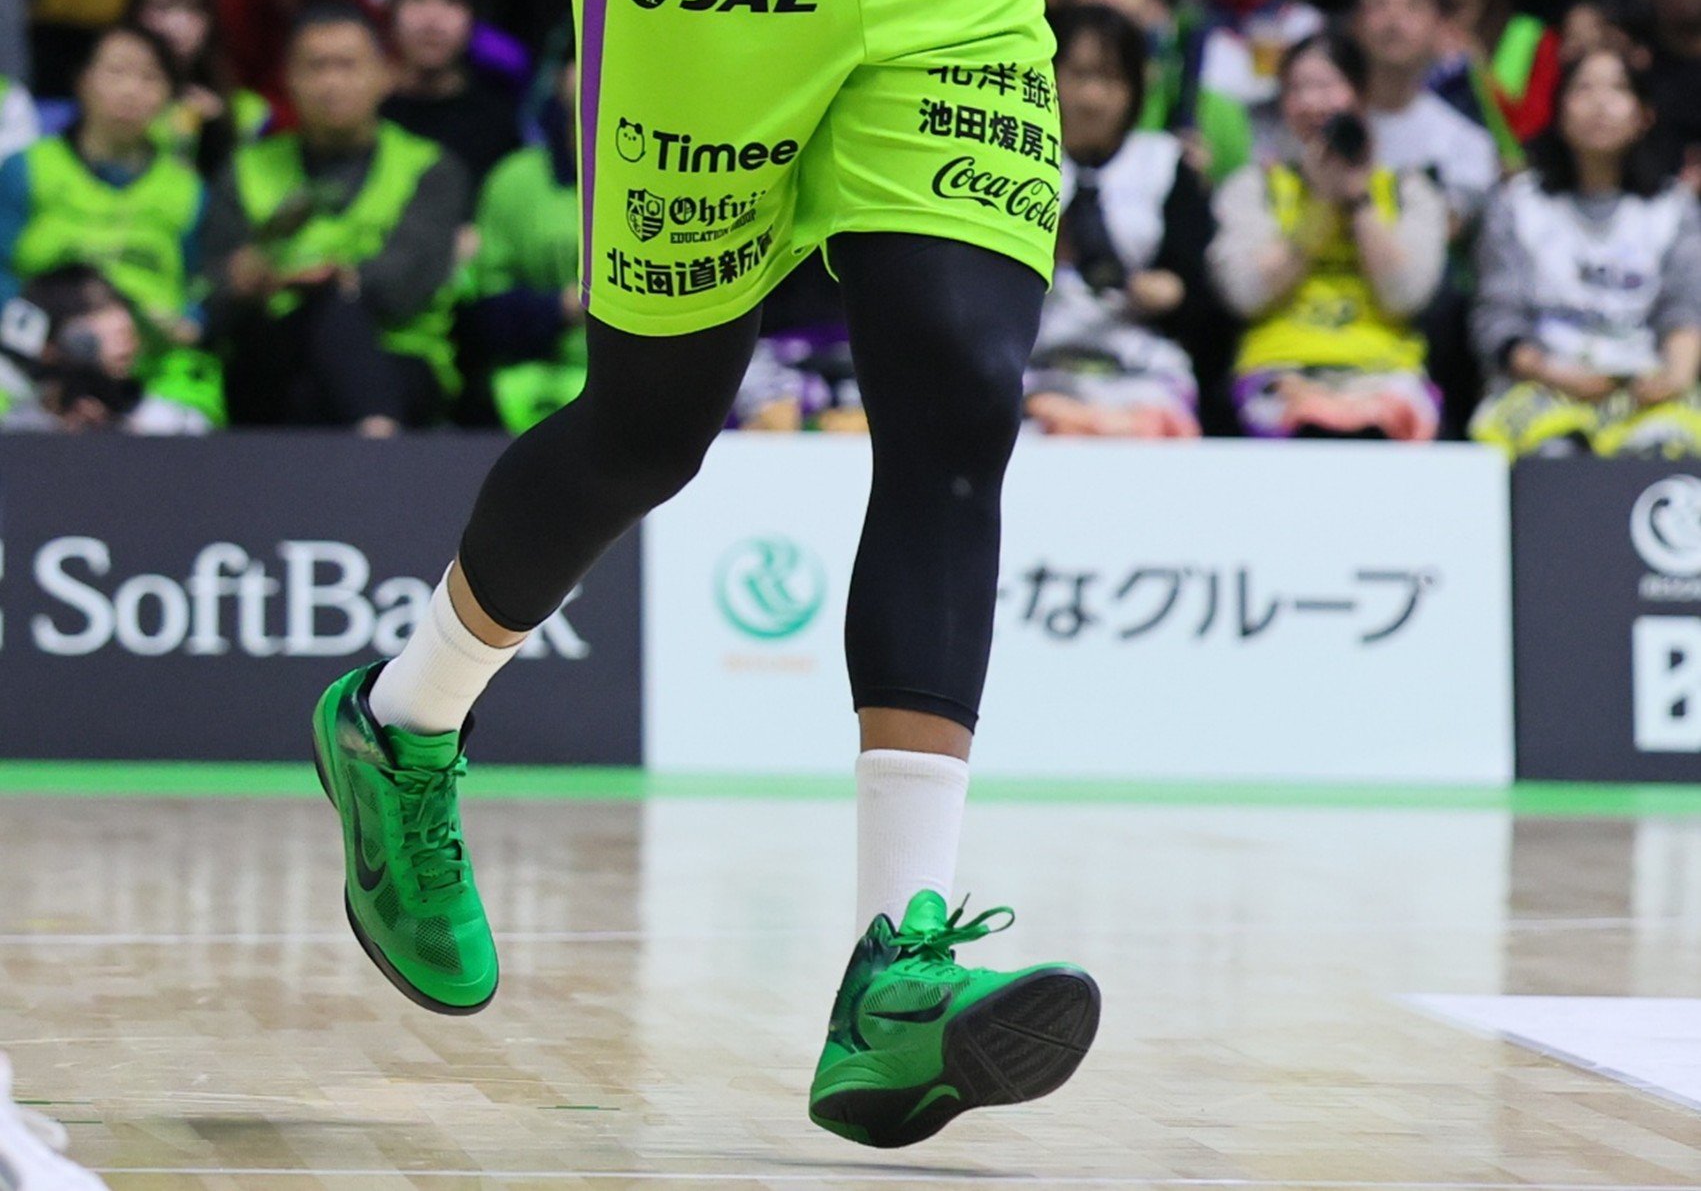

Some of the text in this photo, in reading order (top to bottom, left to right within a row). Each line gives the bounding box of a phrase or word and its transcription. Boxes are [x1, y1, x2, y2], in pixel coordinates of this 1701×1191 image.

[927, 62, 1058, 121] 北洋銀
[652, 130, 799, 173] Timee
[999, 560, 1440, 646] なグループ
